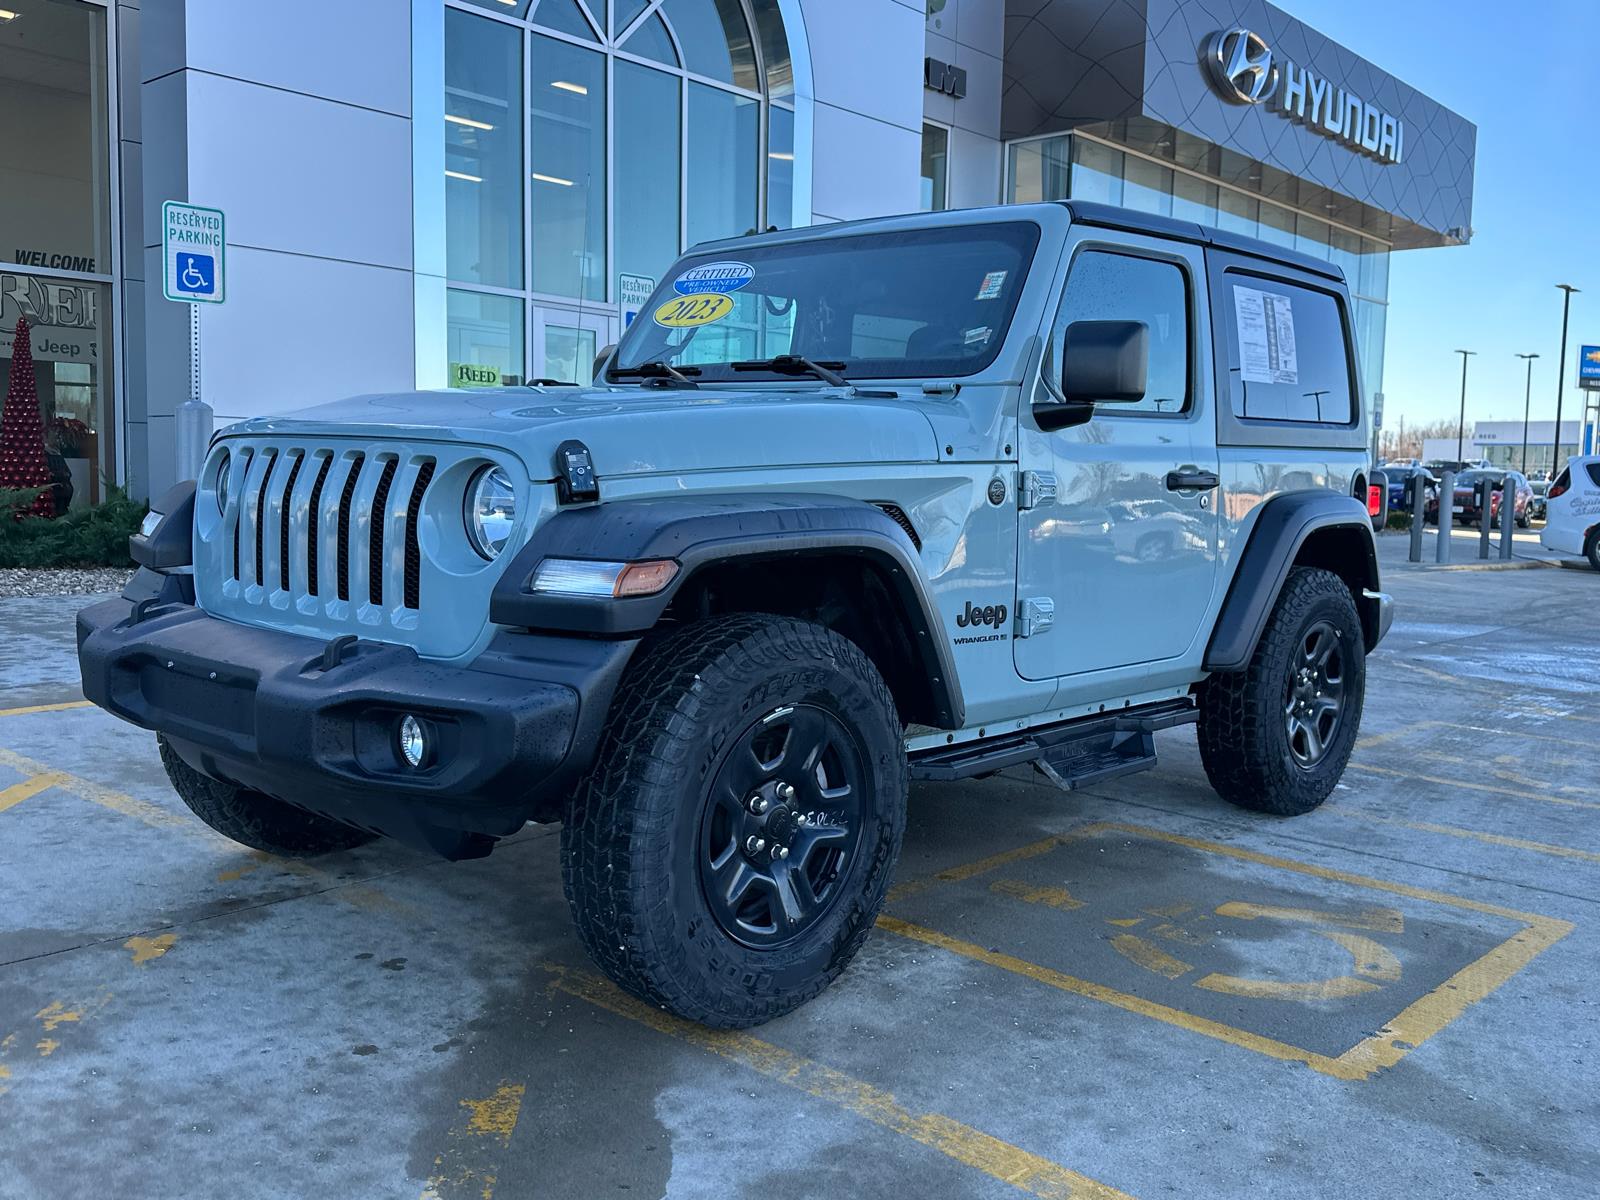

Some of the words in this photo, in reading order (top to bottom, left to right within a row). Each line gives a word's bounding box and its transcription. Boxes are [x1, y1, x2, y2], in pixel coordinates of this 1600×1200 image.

[924, 57, 967, 99] M
[1284, 61, 1404, 164] HYUNDAI
[169, 211, 220, 230] RESERVED
[169, 227, 220, 247] PARKING
[15, 249, 96, 273] WELCOME
[686, 267, 749, 280] CERTIFIED
[622, 280, 652, 293] RESERVED
[682, 280, 740, 289] PRE-OWNED
[661, 298, 724, 321] 2023
[38, 339, 80, 357] Jeep
[457, 365, 497, 383] REED
[956, 600, 1007, 630] Jeep
[953, 634, 1000, 645] WRANGLER
